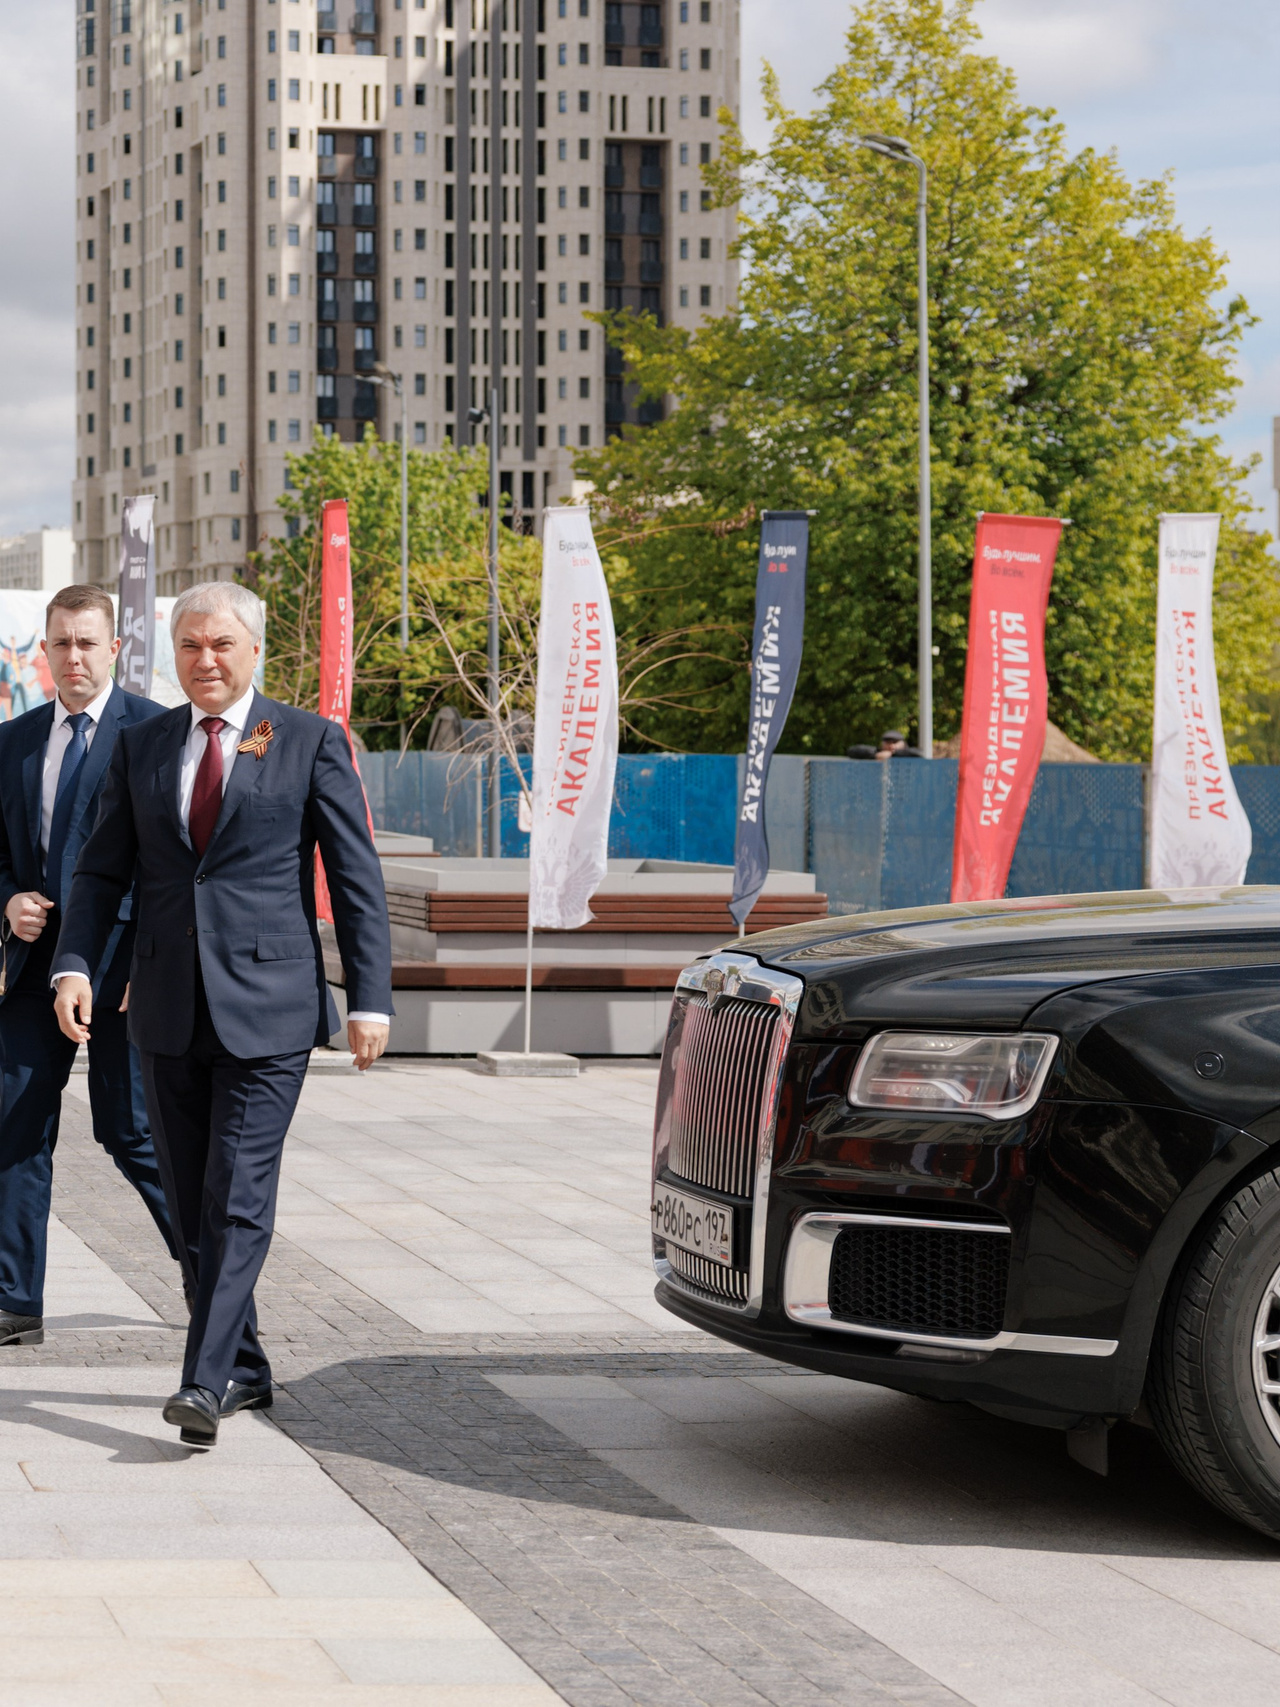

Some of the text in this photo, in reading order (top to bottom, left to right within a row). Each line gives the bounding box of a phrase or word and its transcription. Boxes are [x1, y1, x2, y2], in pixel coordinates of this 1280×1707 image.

[983, 545, 1041, 563] Будь лучшим.
[990, 563, 1000, 575] Во
[547, 603, 581, 816] ИДЕНТСКАЯ
[556, 602, 601, 817] АКАДЕМИЯ
[1172, 610, 1201, 820] ПРЕЗИДЕНТСКАЯ
[1181, 610, 1229, 821] АКАДЕ
[705, 1208, 726, 1244] 197
